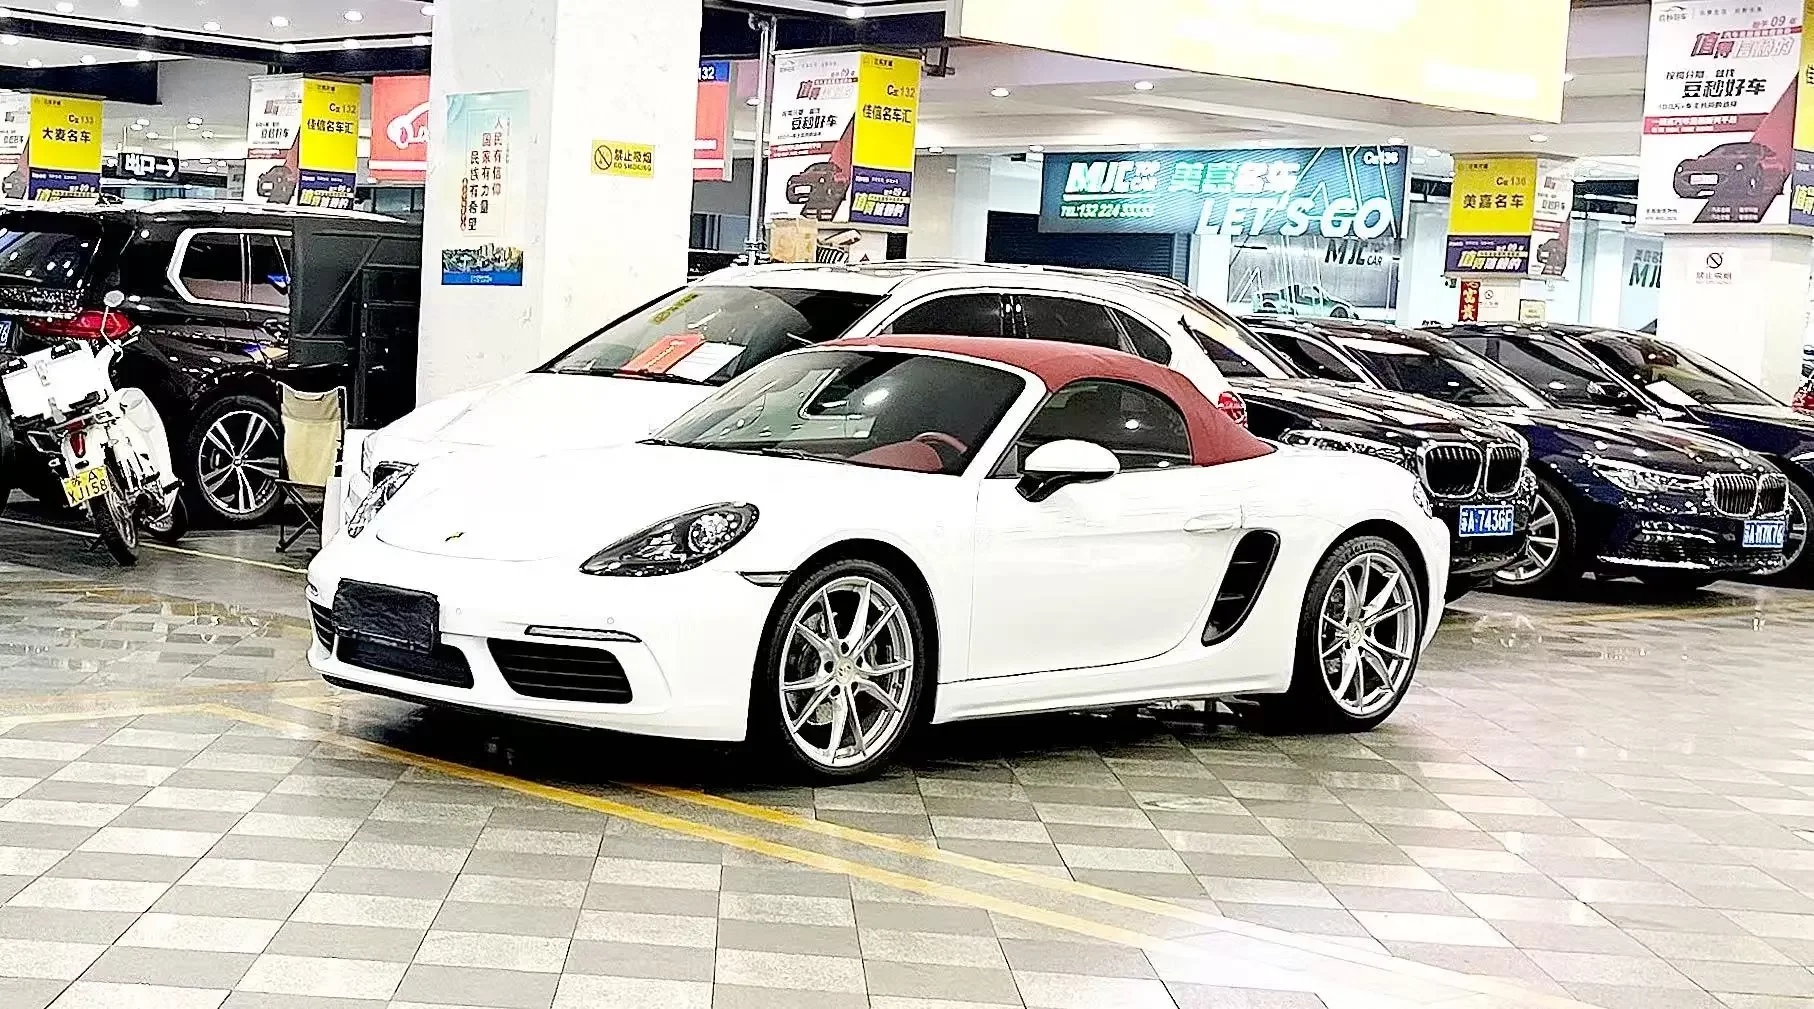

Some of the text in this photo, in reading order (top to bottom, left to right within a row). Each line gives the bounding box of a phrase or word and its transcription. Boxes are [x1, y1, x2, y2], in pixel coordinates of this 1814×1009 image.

[1681, 78, 1767, 99] 豆秒好车
[862, 104, 913, 123] 佳信名车汇
[42, 127, 92, 143] 大麦名车
[125, 153, 156, 176] 出口
[492, 116, 503, 197] 人民有信仰
[614, 148, 652, 164] 禁止吸烟
[480, 132, 491, 214] 国家有力量
[1064, 160, 1135, 193] MJL
[1463, 193, 1526, 209] 美嘉名车
[1319, 197, 1391, 240] GO
[67, 478, 108, 504] XJ158
